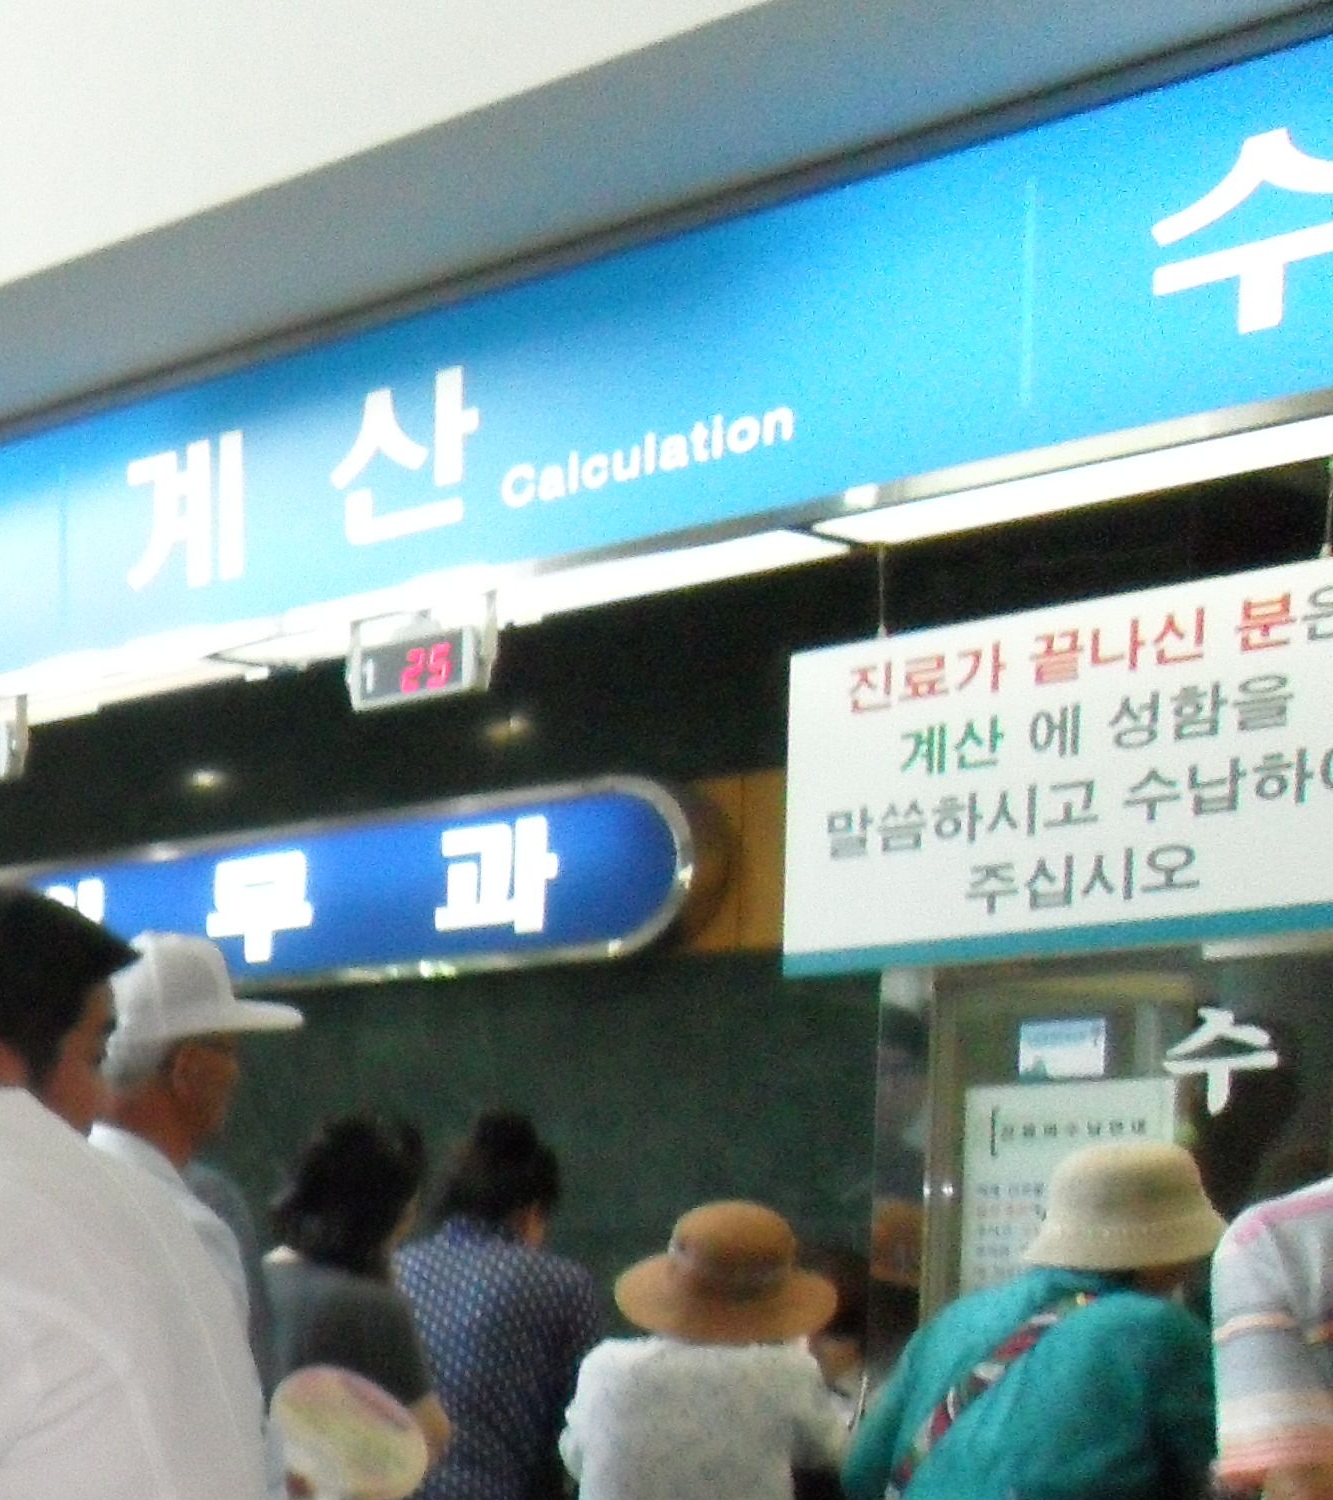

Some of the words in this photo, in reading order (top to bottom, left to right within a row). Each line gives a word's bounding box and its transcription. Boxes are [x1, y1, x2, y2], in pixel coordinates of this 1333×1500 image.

[500, 405, 795, 509] Calculation
[400, 641, 452, 694] 25
[848, 640, 1007, 716] 진료가
[1029, 605, 1206, 686] 끝나신
[900, 712, 1004, 776] 계산
[1029, 702, 1082, 759] 에
[1108, 672, 1295, 751] 성함을
[826, 778, 1099, 862] 말씀하시고
[1122, 746, 1333, 823] 수납하
[965, 842, 1201, 916] 주십시오
